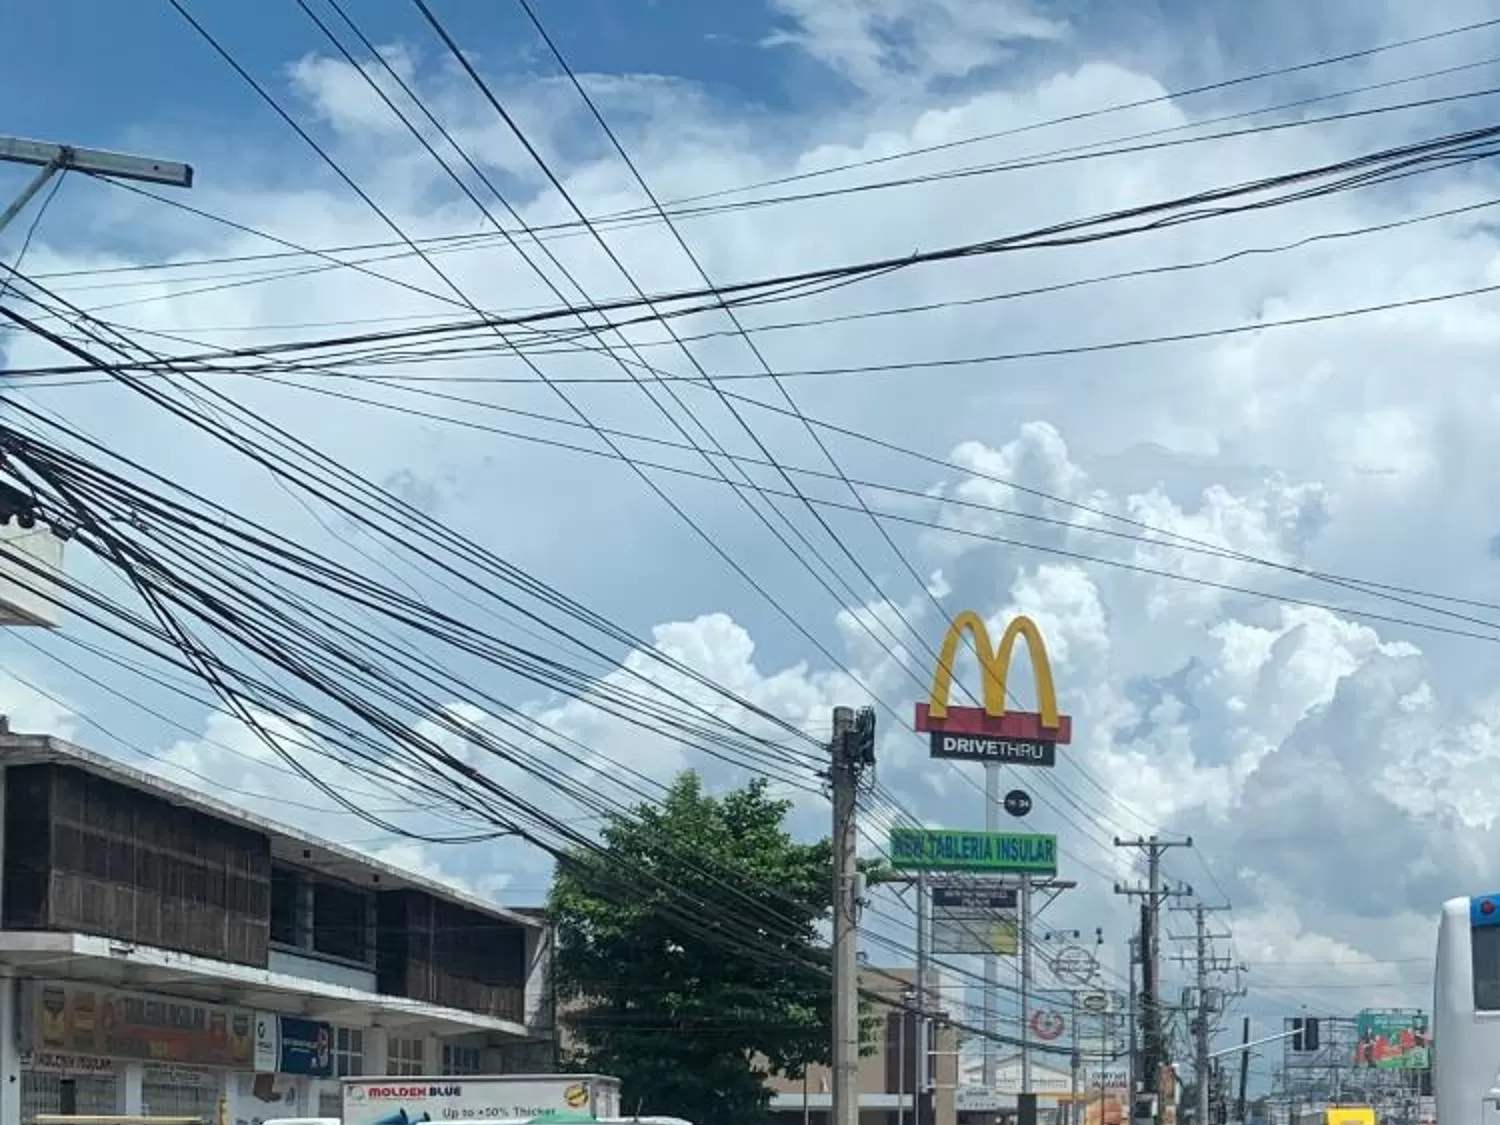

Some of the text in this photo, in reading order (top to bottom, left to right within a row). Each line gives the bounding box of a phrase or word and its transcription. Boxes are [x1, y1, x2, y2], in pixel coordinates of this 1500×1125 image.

[997, 837, 1055, 863] INSULAR
[428, 1086, 462, 1097] BLUE
[442, 1107, 459, 1119] Up
[463, 1109, 474, 1118] to
[513, 1106, 556, 1118] Thicker
